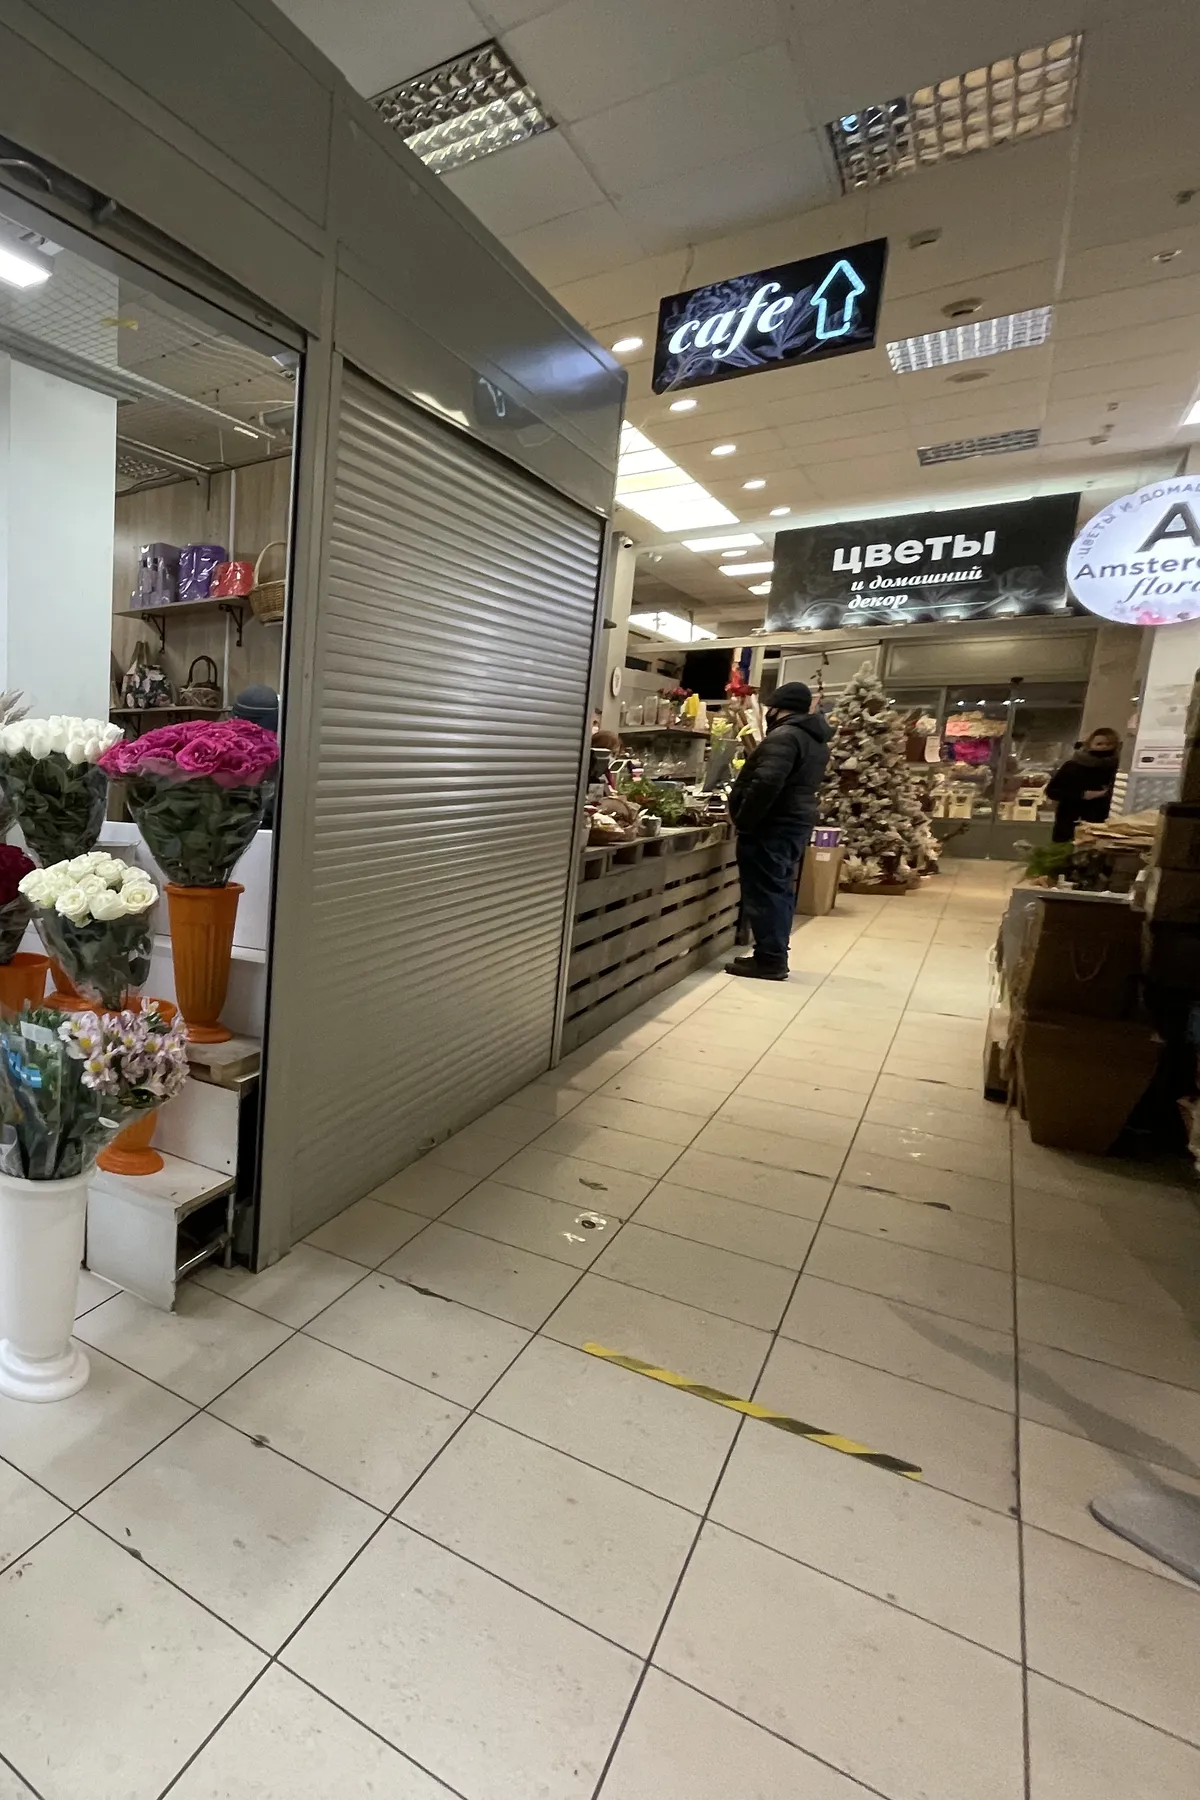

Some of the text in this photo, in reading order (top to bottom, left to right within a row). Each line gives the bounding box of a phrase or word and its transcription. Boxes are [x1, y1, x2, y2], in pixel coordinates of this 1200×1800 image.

[668, 282, 794, 359] cafe
[851, 565, 983, 592] и домашний
[1073, 556, 1200, 580] Amster
[848, 594, 909, 610] декор
